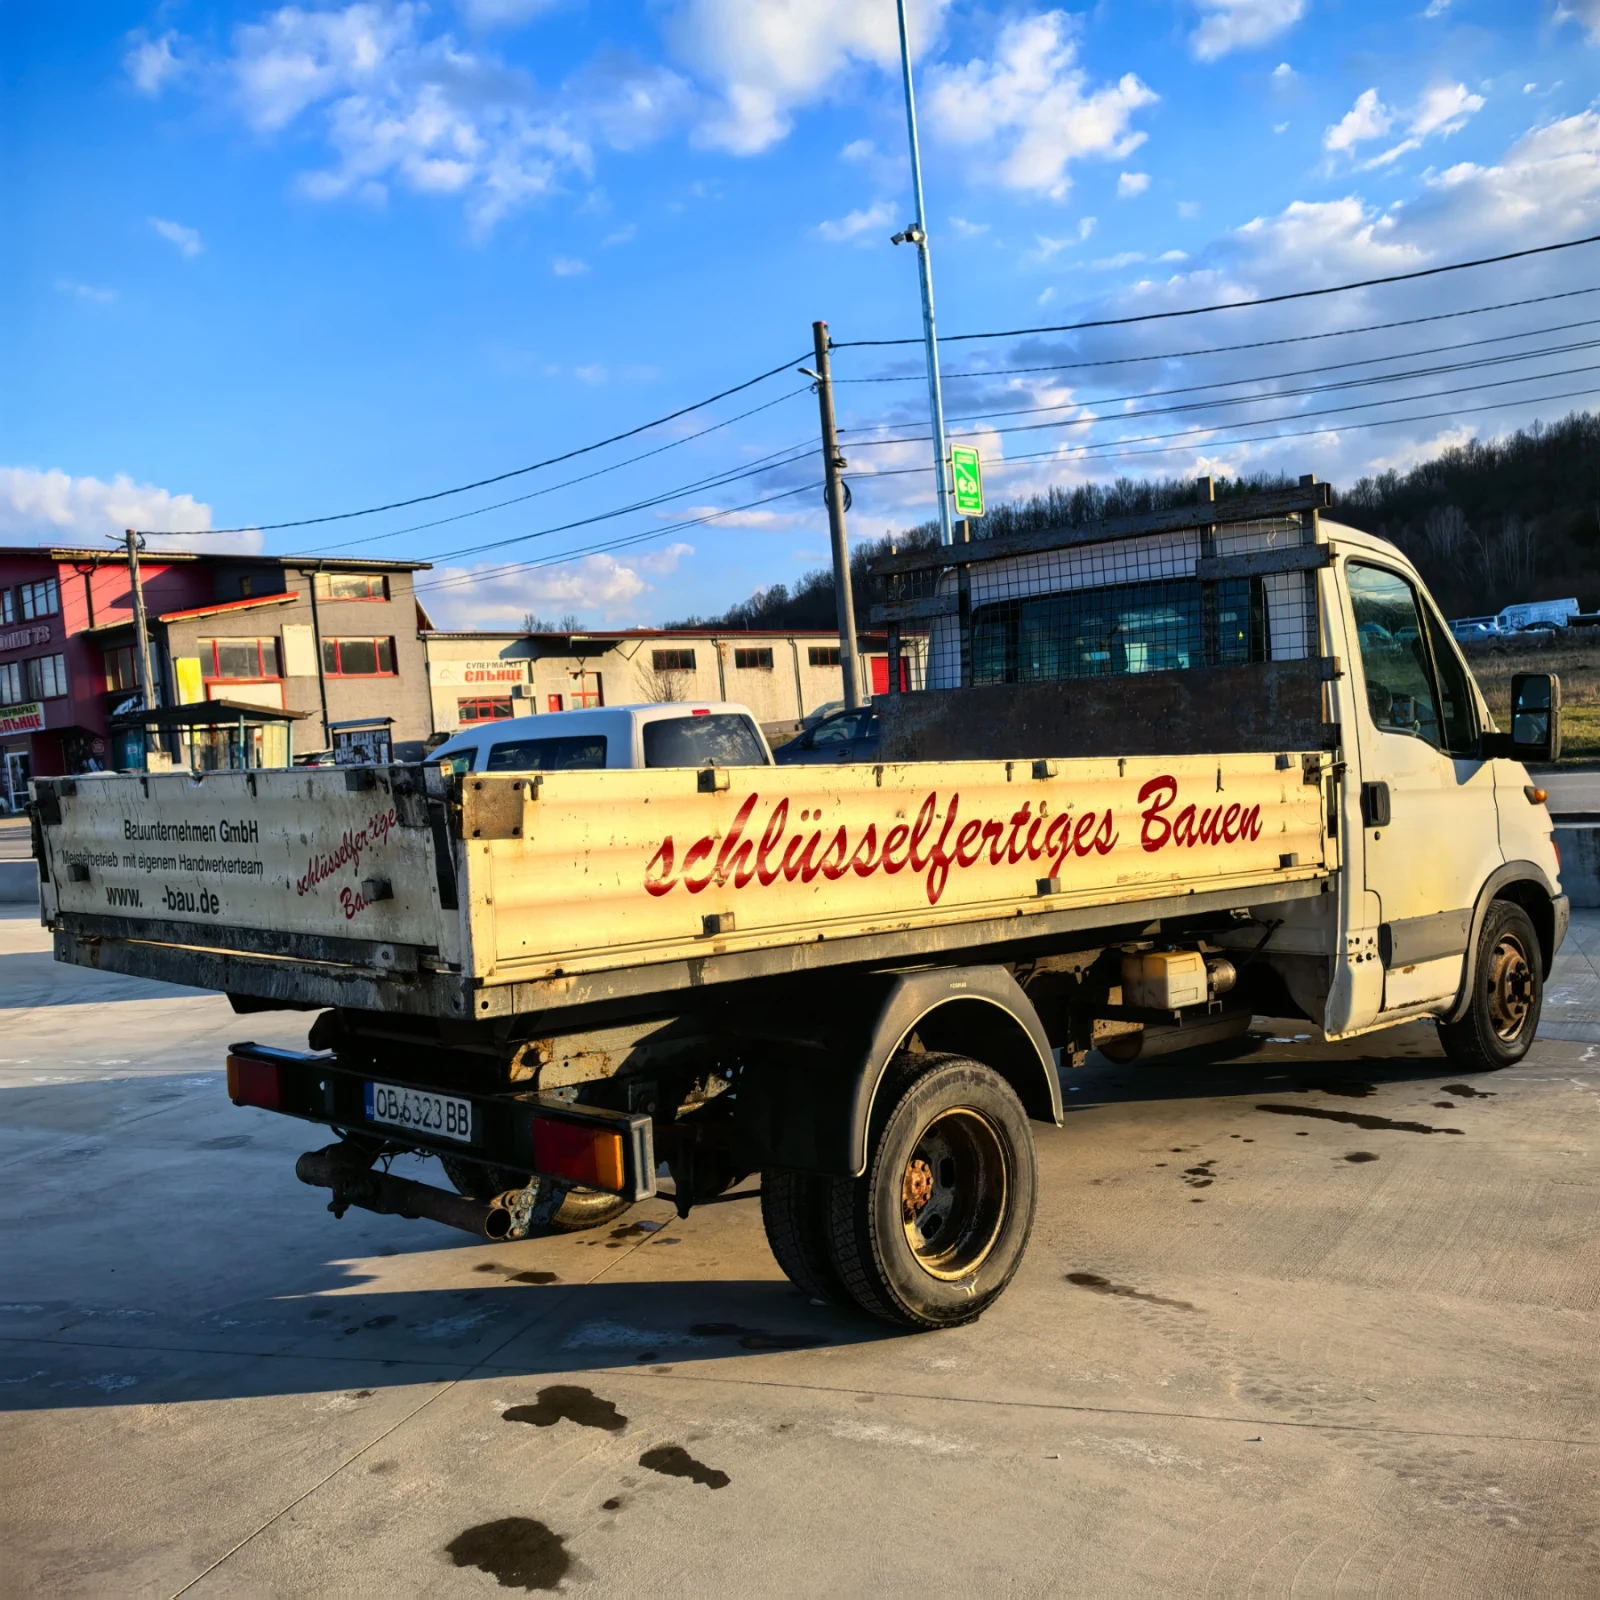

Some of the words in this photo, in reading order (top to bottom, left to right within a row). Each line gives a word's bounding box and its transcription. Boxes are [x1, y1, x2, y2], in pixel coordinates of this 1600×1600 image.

[464, 669, 523, 683] СЛЪНЦЕ
[466, 661, 522, 669] СУПЕРМАРКЕТ
[0, 704, 37, 719] ПЕРМАРКЕТ
[124, 819, 217, 842] Bauunternehmen
[219, 819, 259, 843] GmbH
[643, 790, 1119, 906] schlüsselfertiges
[1137, 774, 1264, 853] Bauen
[61, 849, 118, 868] Meisterbetrieb
[122, 852, 137, 868] mit
[138, 853, 177, 873] eigenem
[178, 853, 264, 875] Handwerkerteam
[296, 808, 398, 897] schlüsselfertige
[106, 887, 143, 908] www.
[162, 885, 220, 915] -bau.de
[376, 1088, 399, 1120] OB
[446, 1101, 469, 1136] BB
